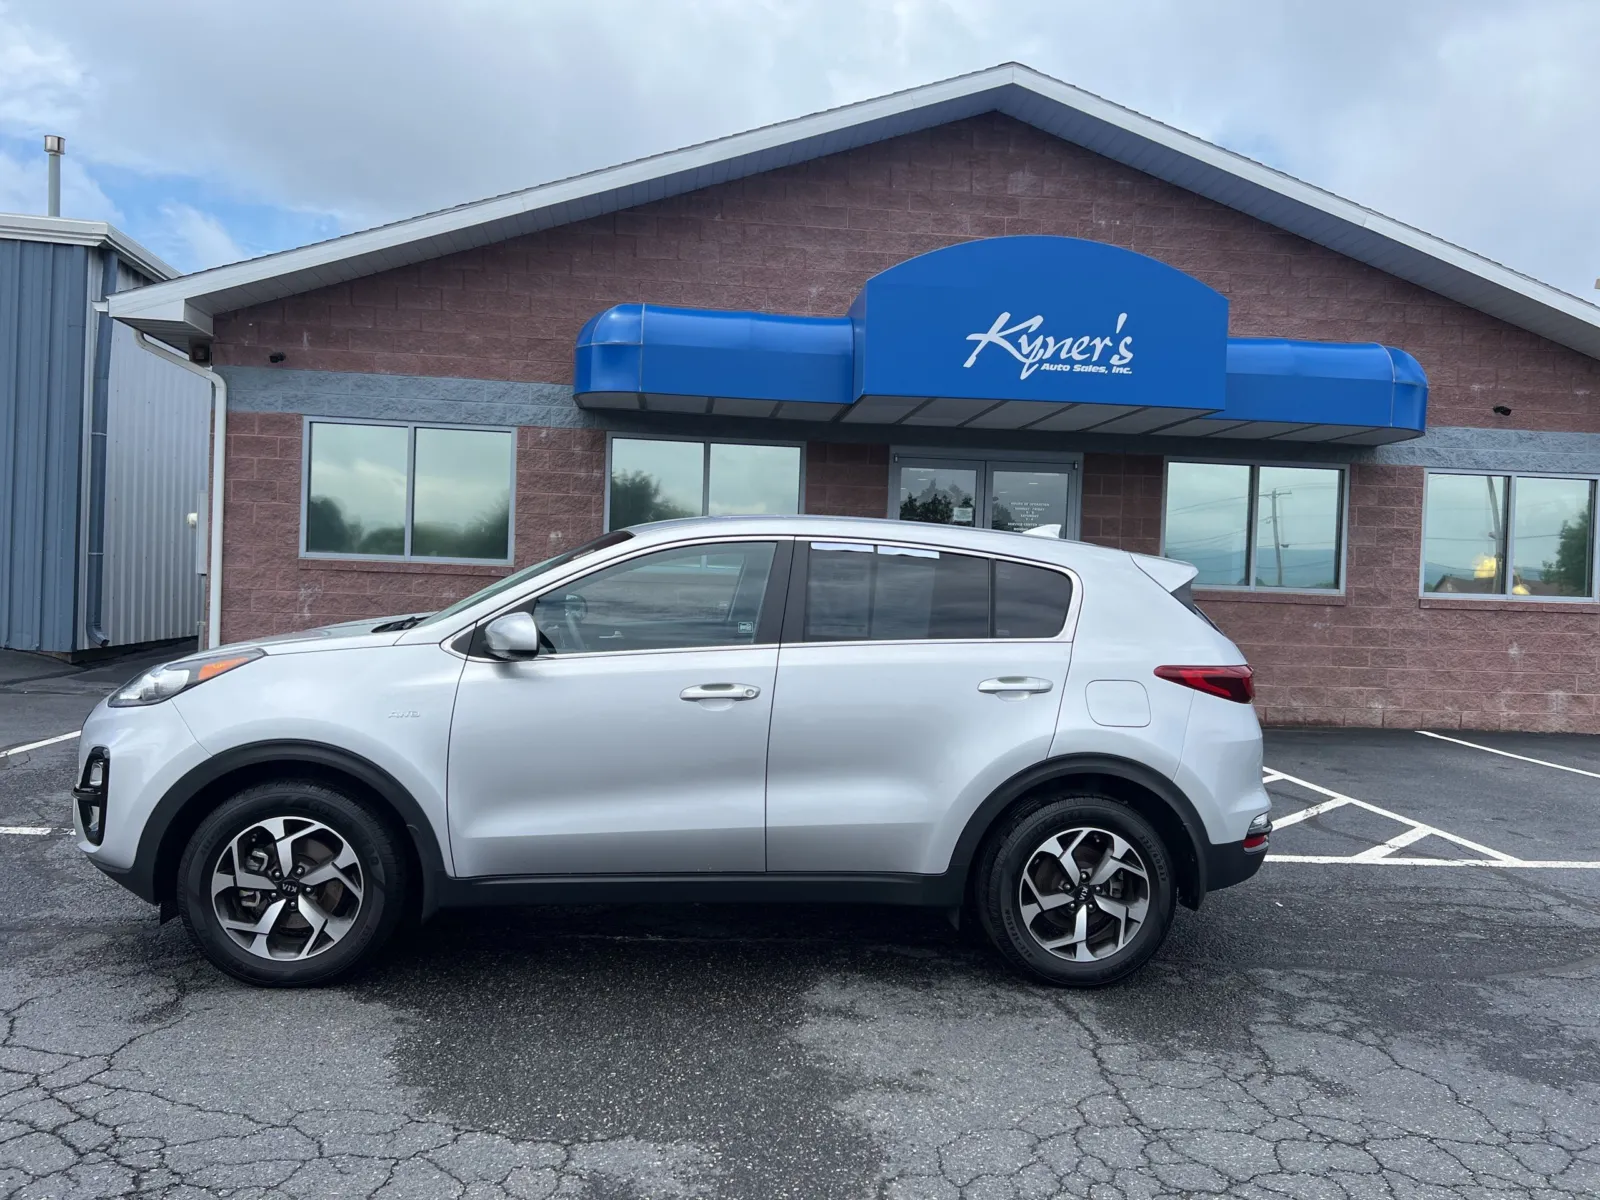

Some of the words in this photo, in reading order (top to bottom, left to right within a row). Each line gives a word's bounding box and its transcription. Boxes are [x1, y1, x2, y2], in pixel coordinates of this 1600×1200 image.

[963, 311, 1133, 380] Kyner's
[1040, 363, 1070, 372] Auto
[1072, 364, 1108, 374] Sales,
[1112, 365, 1132, 374] Inc.
[388, 710, 420, 718] AWD
[282, 883, 298, 893] KIA
[1078, 886, 1089, 900] KIA
